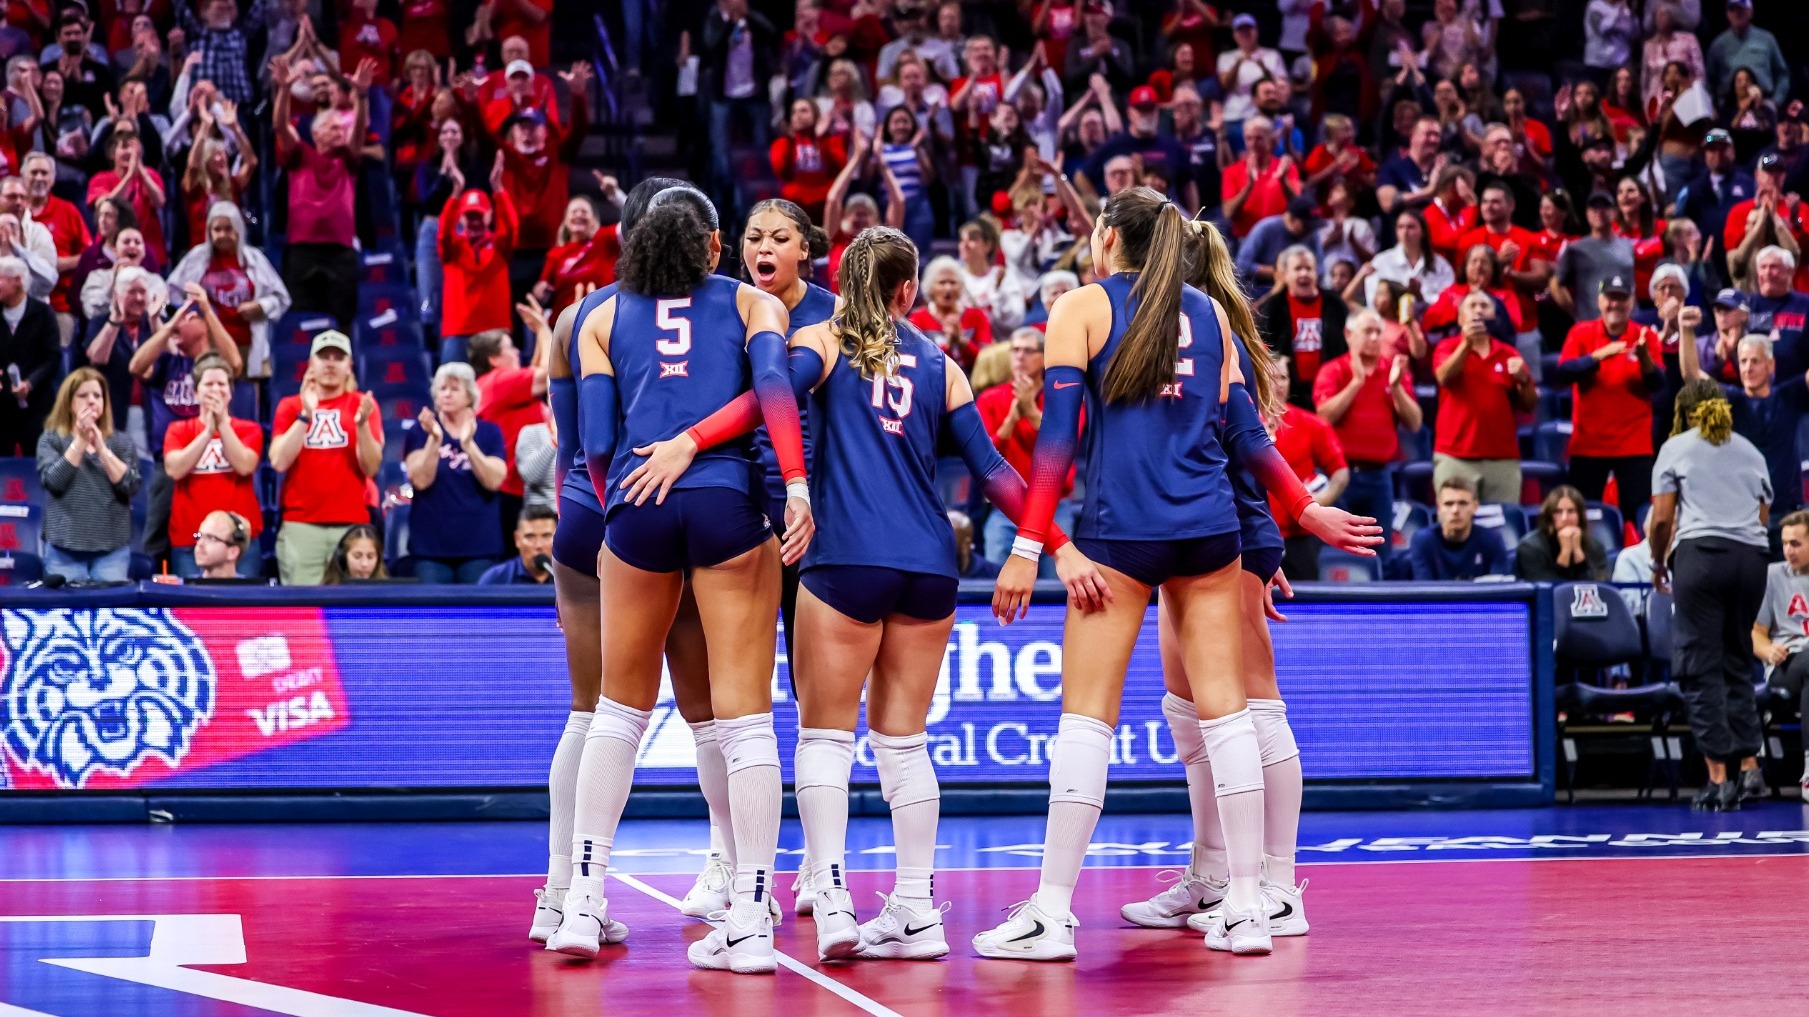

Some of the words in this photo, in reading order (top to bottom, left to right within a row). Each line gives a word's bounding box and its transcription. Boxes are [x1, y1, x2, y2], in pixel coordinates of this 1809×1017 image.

[656, 297, 692, 356] 5
[872, 353, 917, 419] 15
[304, 408, 349, 450] A
[1570, 584, 1608, 618] A
[244, 690, 336, 737] VISA
